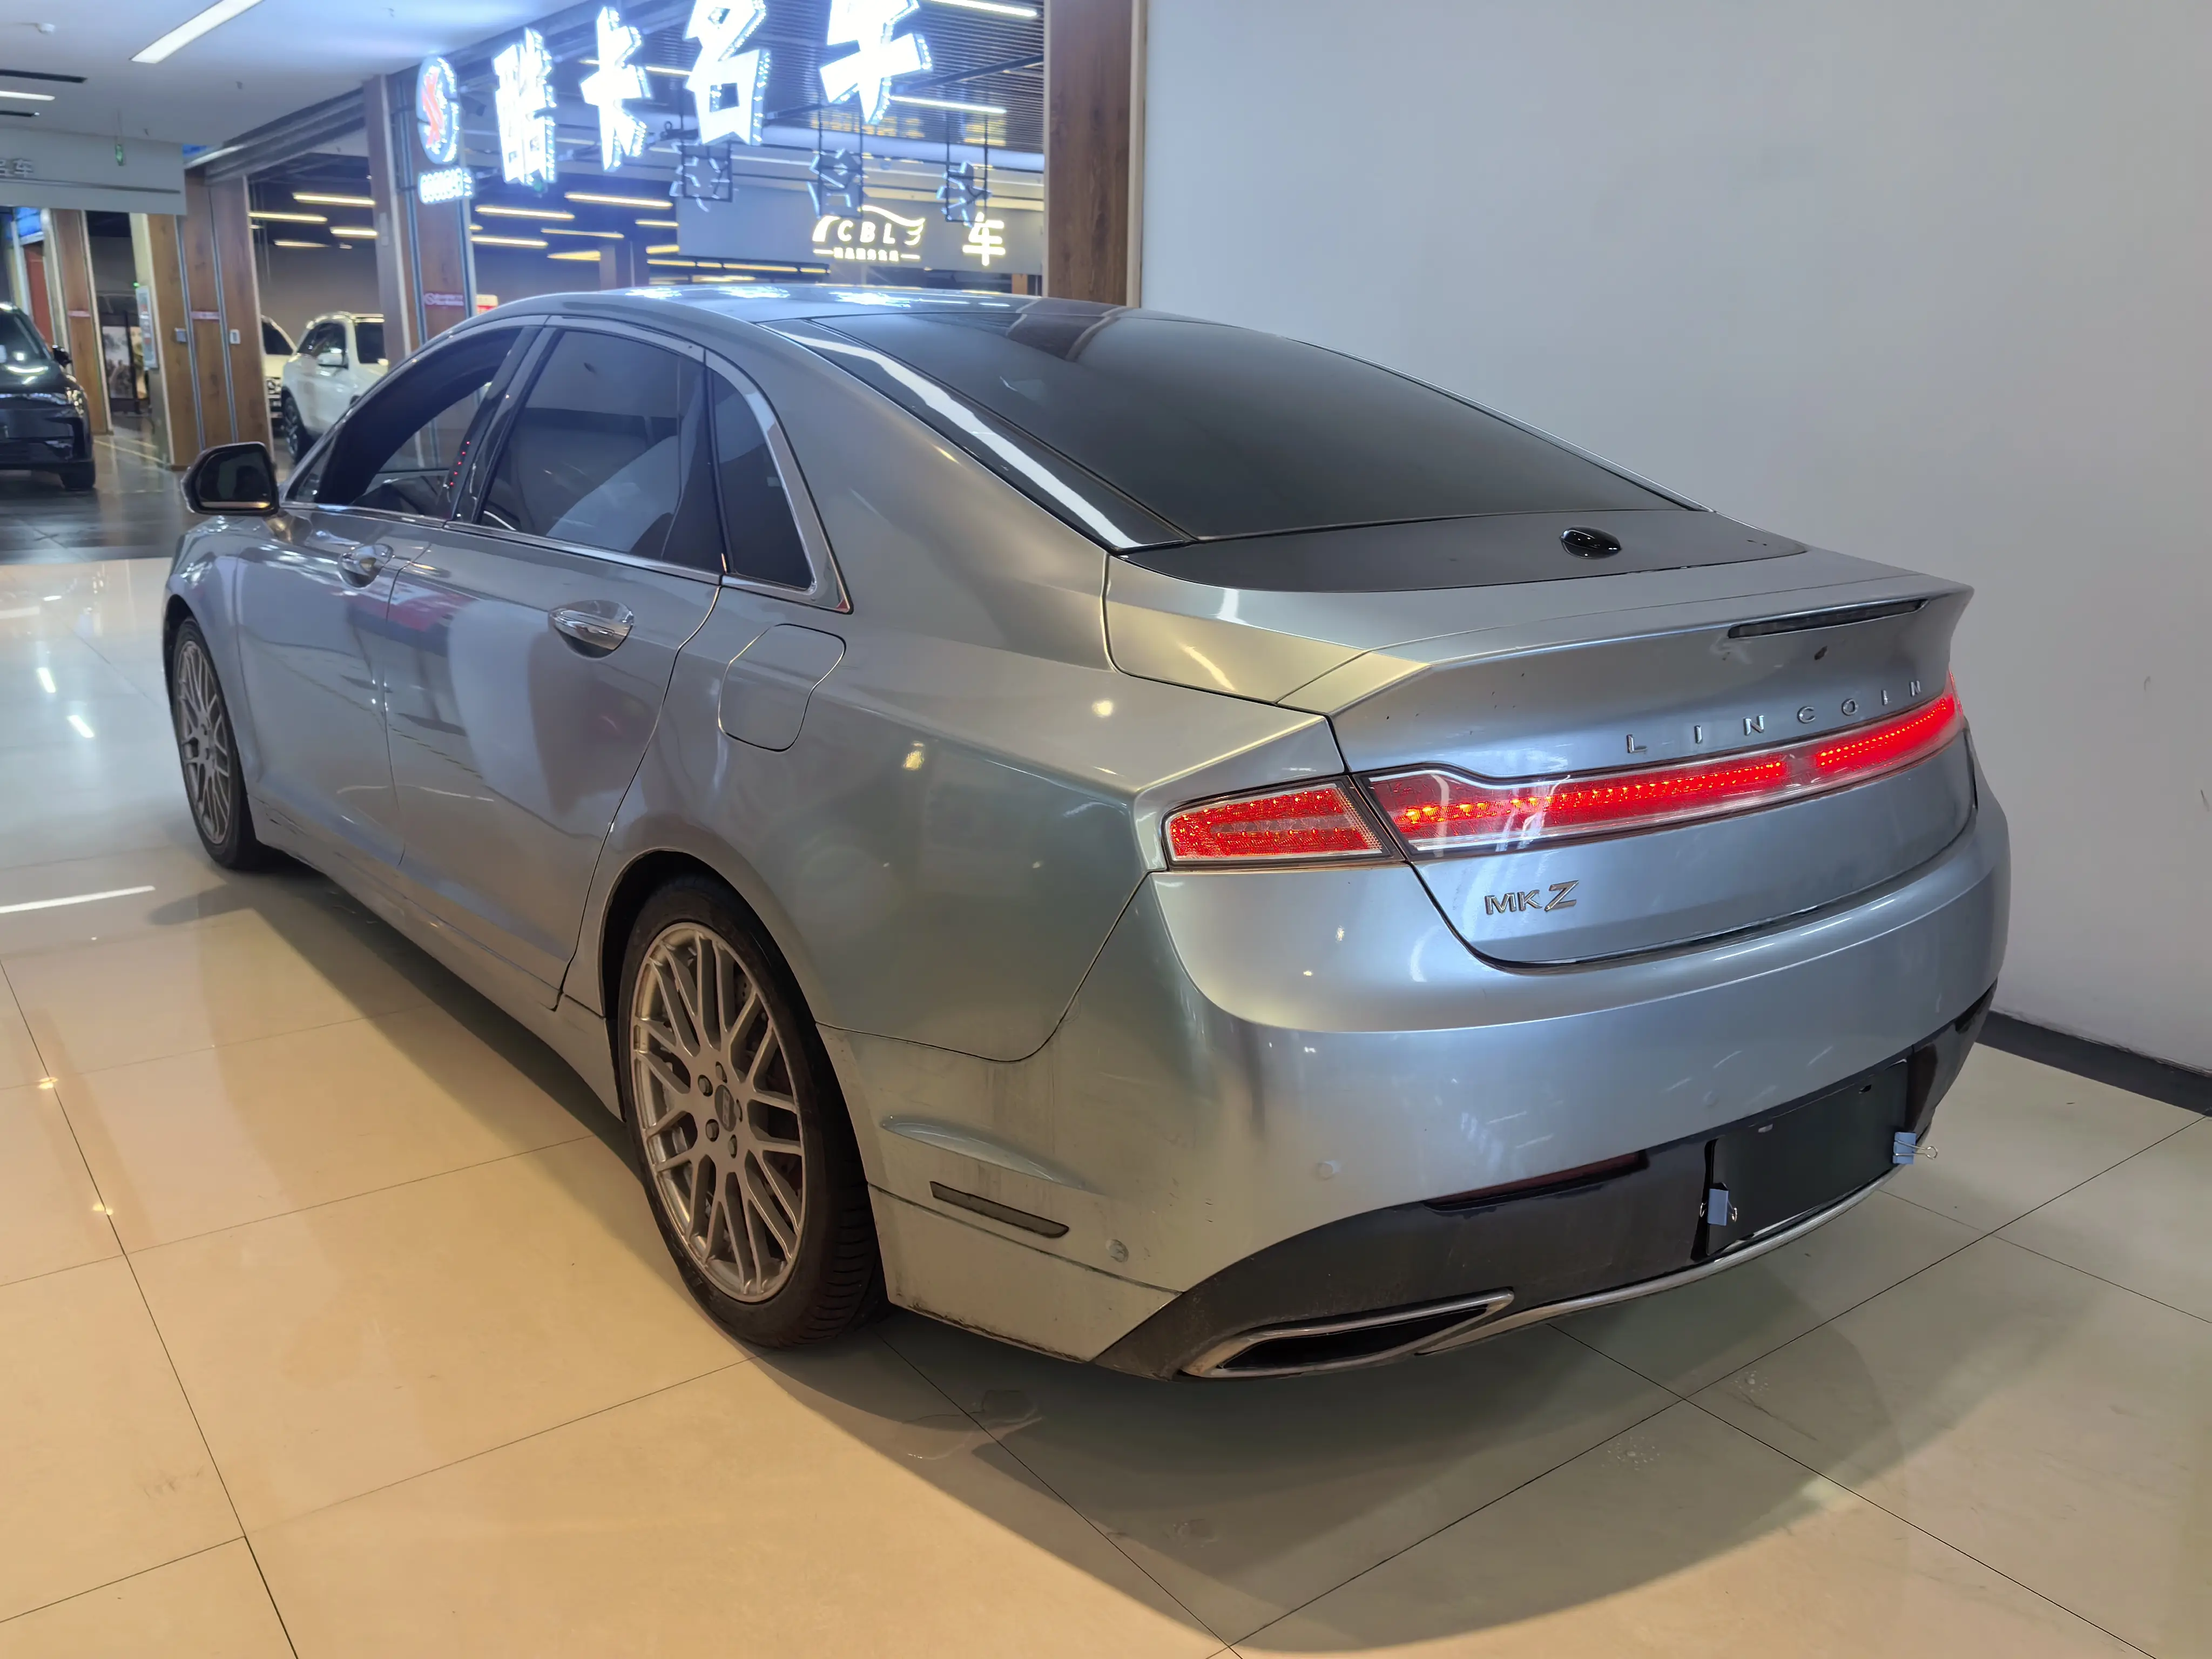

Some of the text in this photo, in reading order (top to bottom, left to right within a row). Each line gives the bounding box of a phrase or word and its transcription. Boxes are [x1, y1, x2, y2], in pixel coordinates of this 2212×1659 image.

[837, 220, 896, 245] CBL
[961, 211, 1007, 267] 车
[1626, 679, 1922, 754] LINCOLN
[1483, 879, 1580, 915] MKZ
